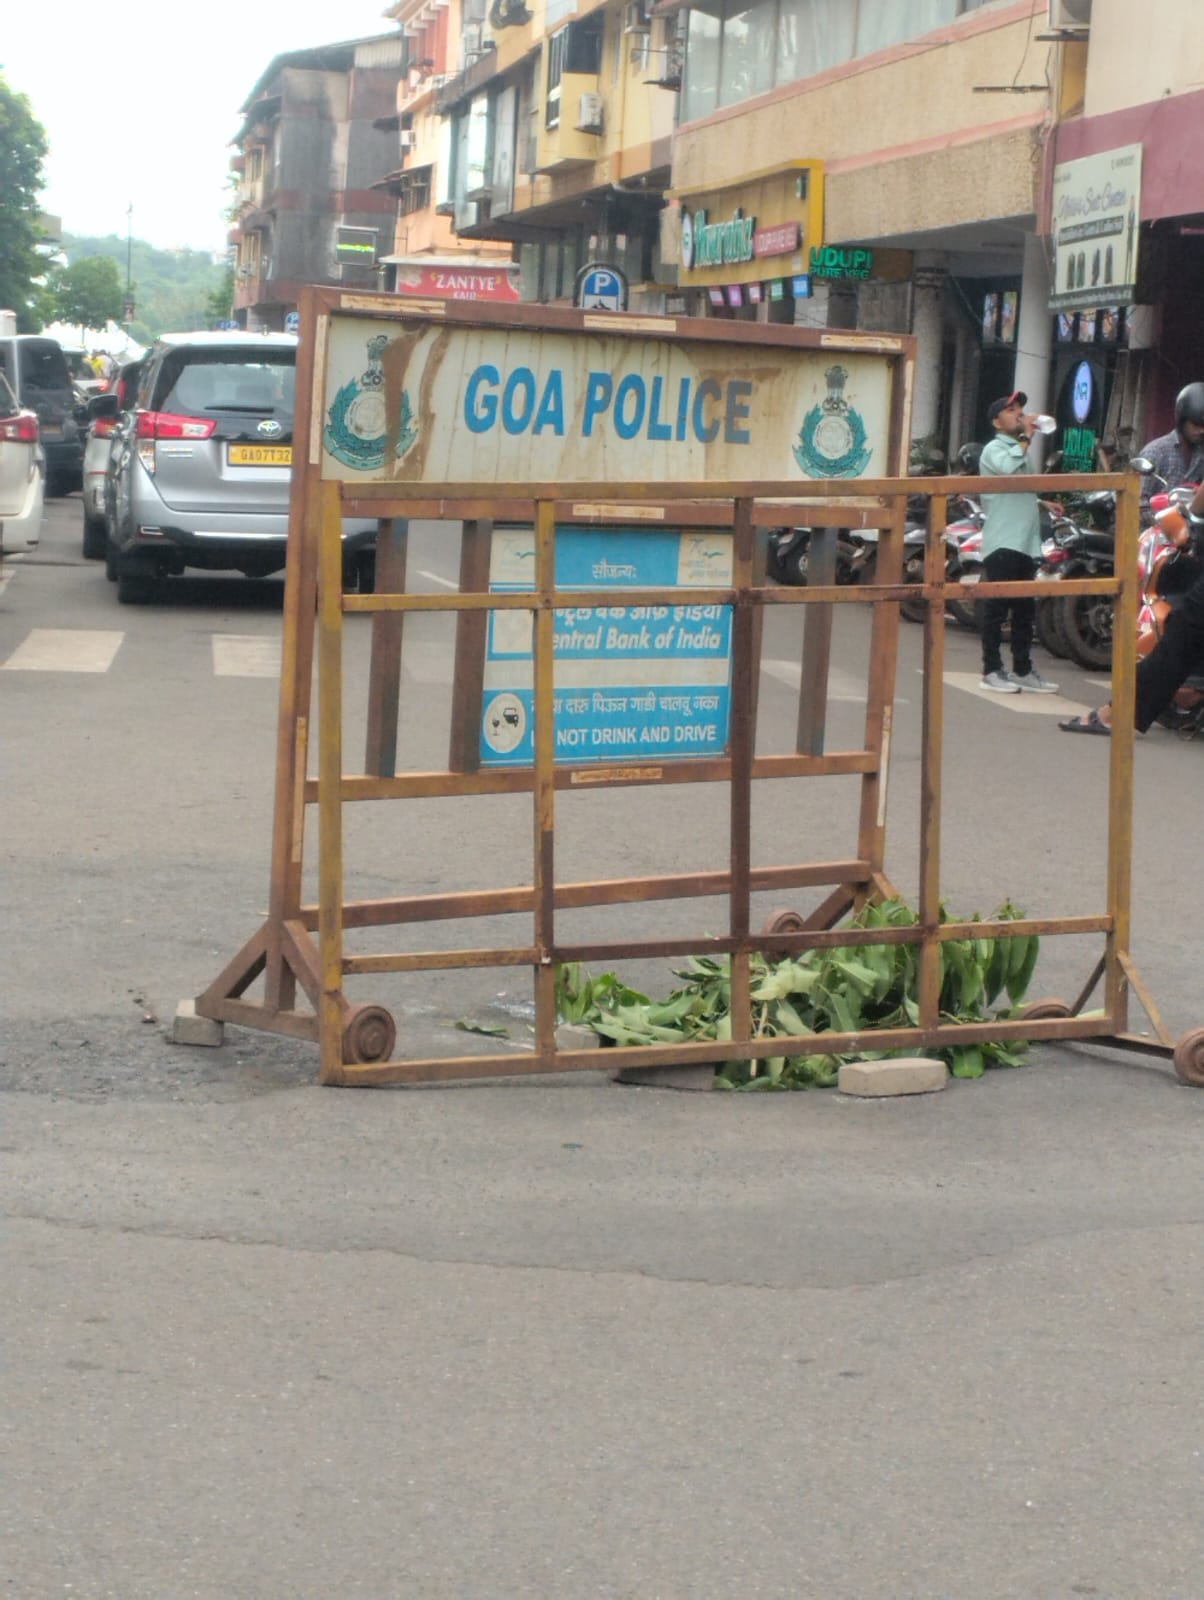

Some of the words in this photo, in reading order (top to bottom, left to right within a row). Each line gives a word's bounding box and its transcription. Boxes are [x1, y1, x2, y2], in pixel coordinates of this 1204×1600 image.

[810, 246, 873, 268] UDUPI
[594, 274, 612, 294] P
[464, 365, 565, 435] GOA
[582, 371, 753, 444] POLICE
[553, 625, 603, 649] entral
[606, 625, 649, 649] Bank
[654, 625, 676, 649] of
[677, 625, 722, 649] India
[557, 729, 588, 745] NOT
[592, 727, 637, 744] DRINK
[640, 725, 670, 742] AND
[674, 724, 717, 741] DRIVE
